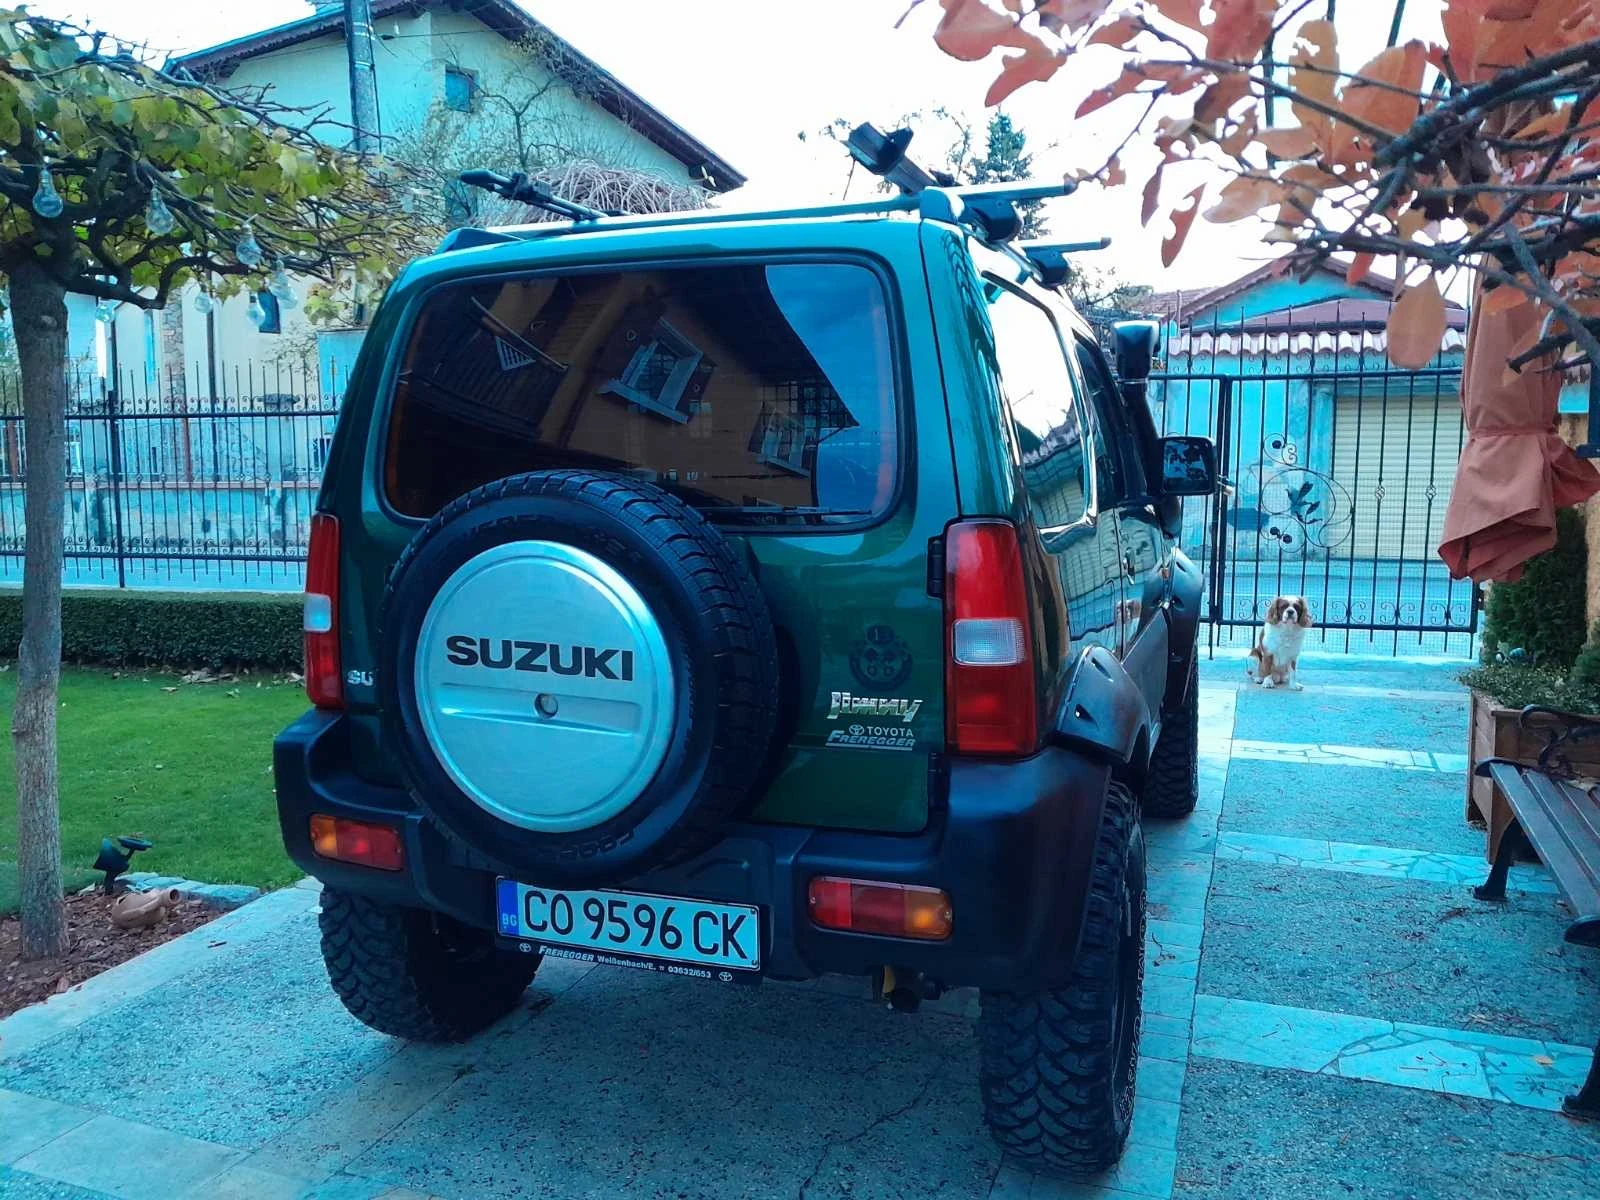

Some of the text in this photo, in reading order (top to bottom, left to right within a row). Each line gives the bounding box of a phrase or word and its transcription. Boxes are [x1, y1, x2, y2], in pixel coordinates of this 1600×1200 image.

[446, 635, 633, 681] SUZUKI
[867, 726, 914, 737] TOYOTA
[502, 913, 518, 927] BG
[583, 897, 683, 950] 9596
[692, 910, 748, 960] CK
